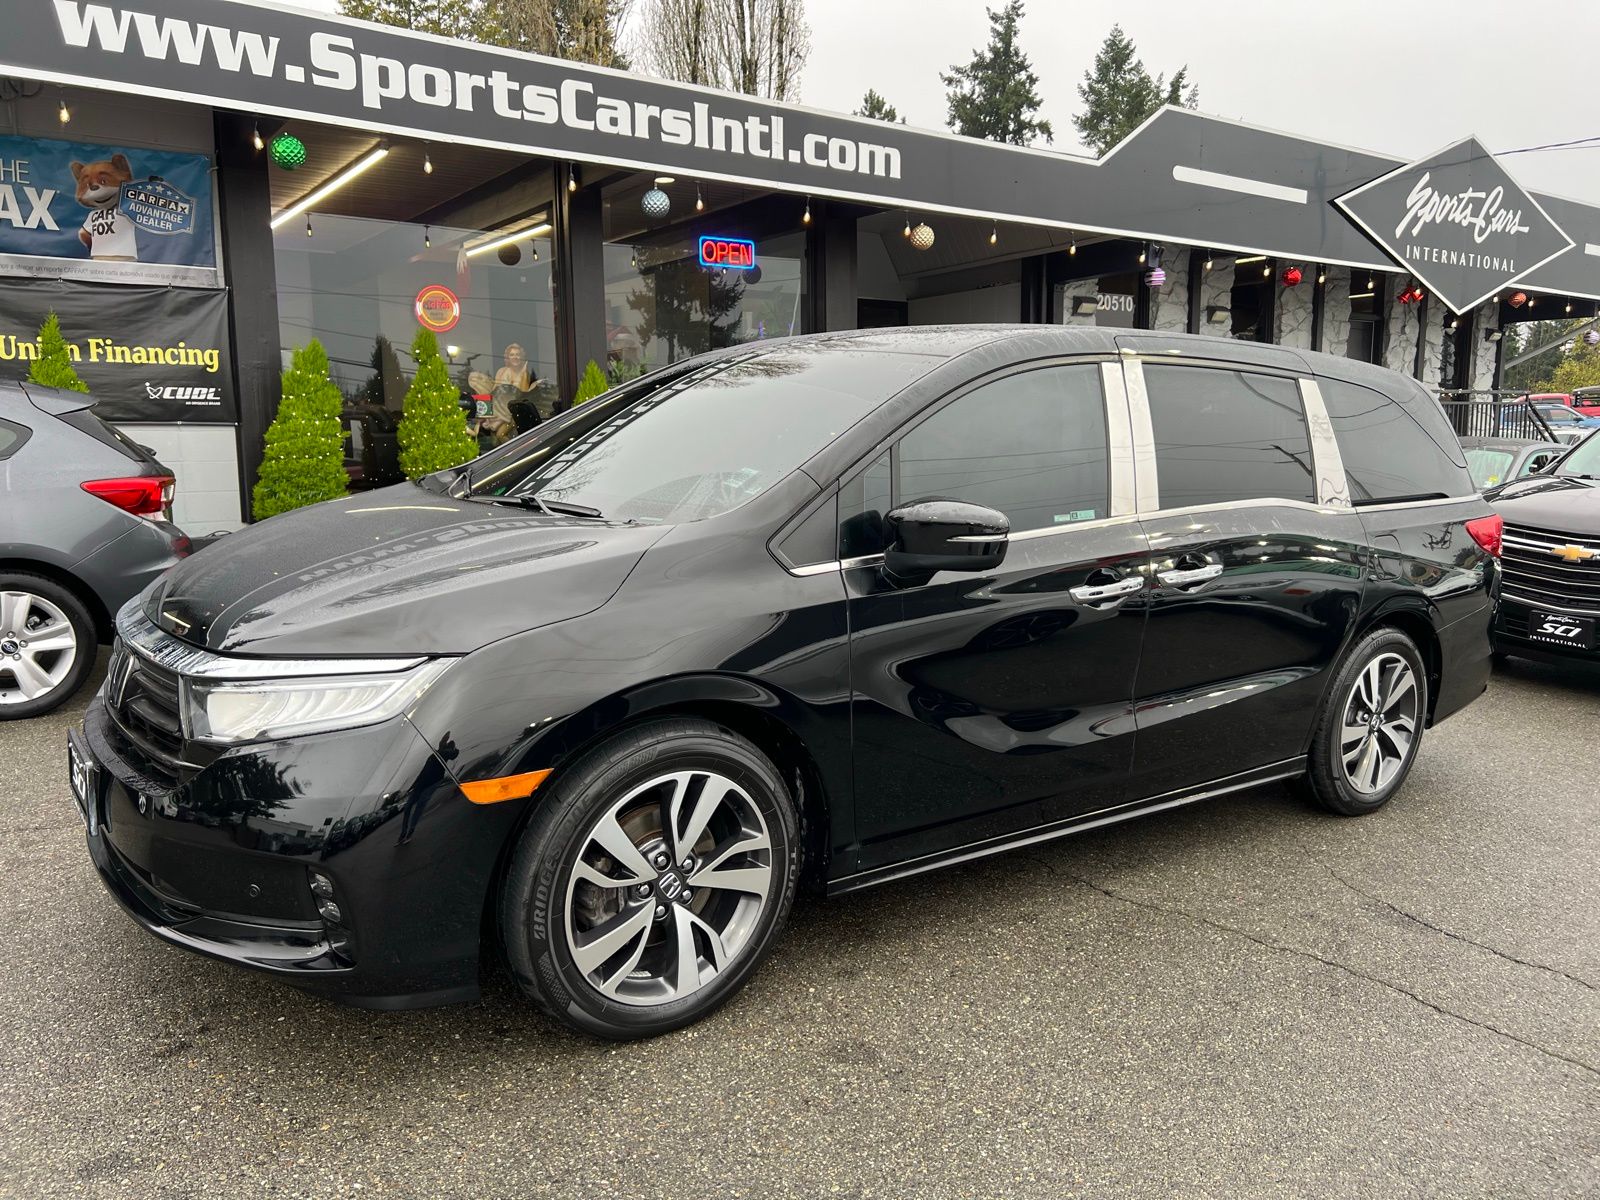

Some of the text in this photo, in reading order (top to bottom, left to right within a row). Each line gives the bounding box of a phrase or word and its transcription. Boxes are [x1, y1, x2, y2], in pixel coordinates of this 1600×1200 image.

[54, 0, 901, 179] www.SportsCarsIntl.com
[127, 190, 188, 214] CARFAX
[1395, 172, 1529, 243] Sports Cars
[91, 208, 115, 222] CAR
[129, 203, 183, 224] ADVANTAGE
[136, 214, 173, 231] DEALER
[92, 221, 115, 236] FOX
[702, 240, 752, 265] OPEN
[1406, 245, 1516, 273] INTERNATIONAL
[1096, 294, 1134, 312] 20510
[0, 335, 219, 373] Unin Financing
[163, 386, 221, 400] CUDL
[1537, 622, 1582, 637] SCI
[1530, 635, 1586, 648] INTERNATIONAL
